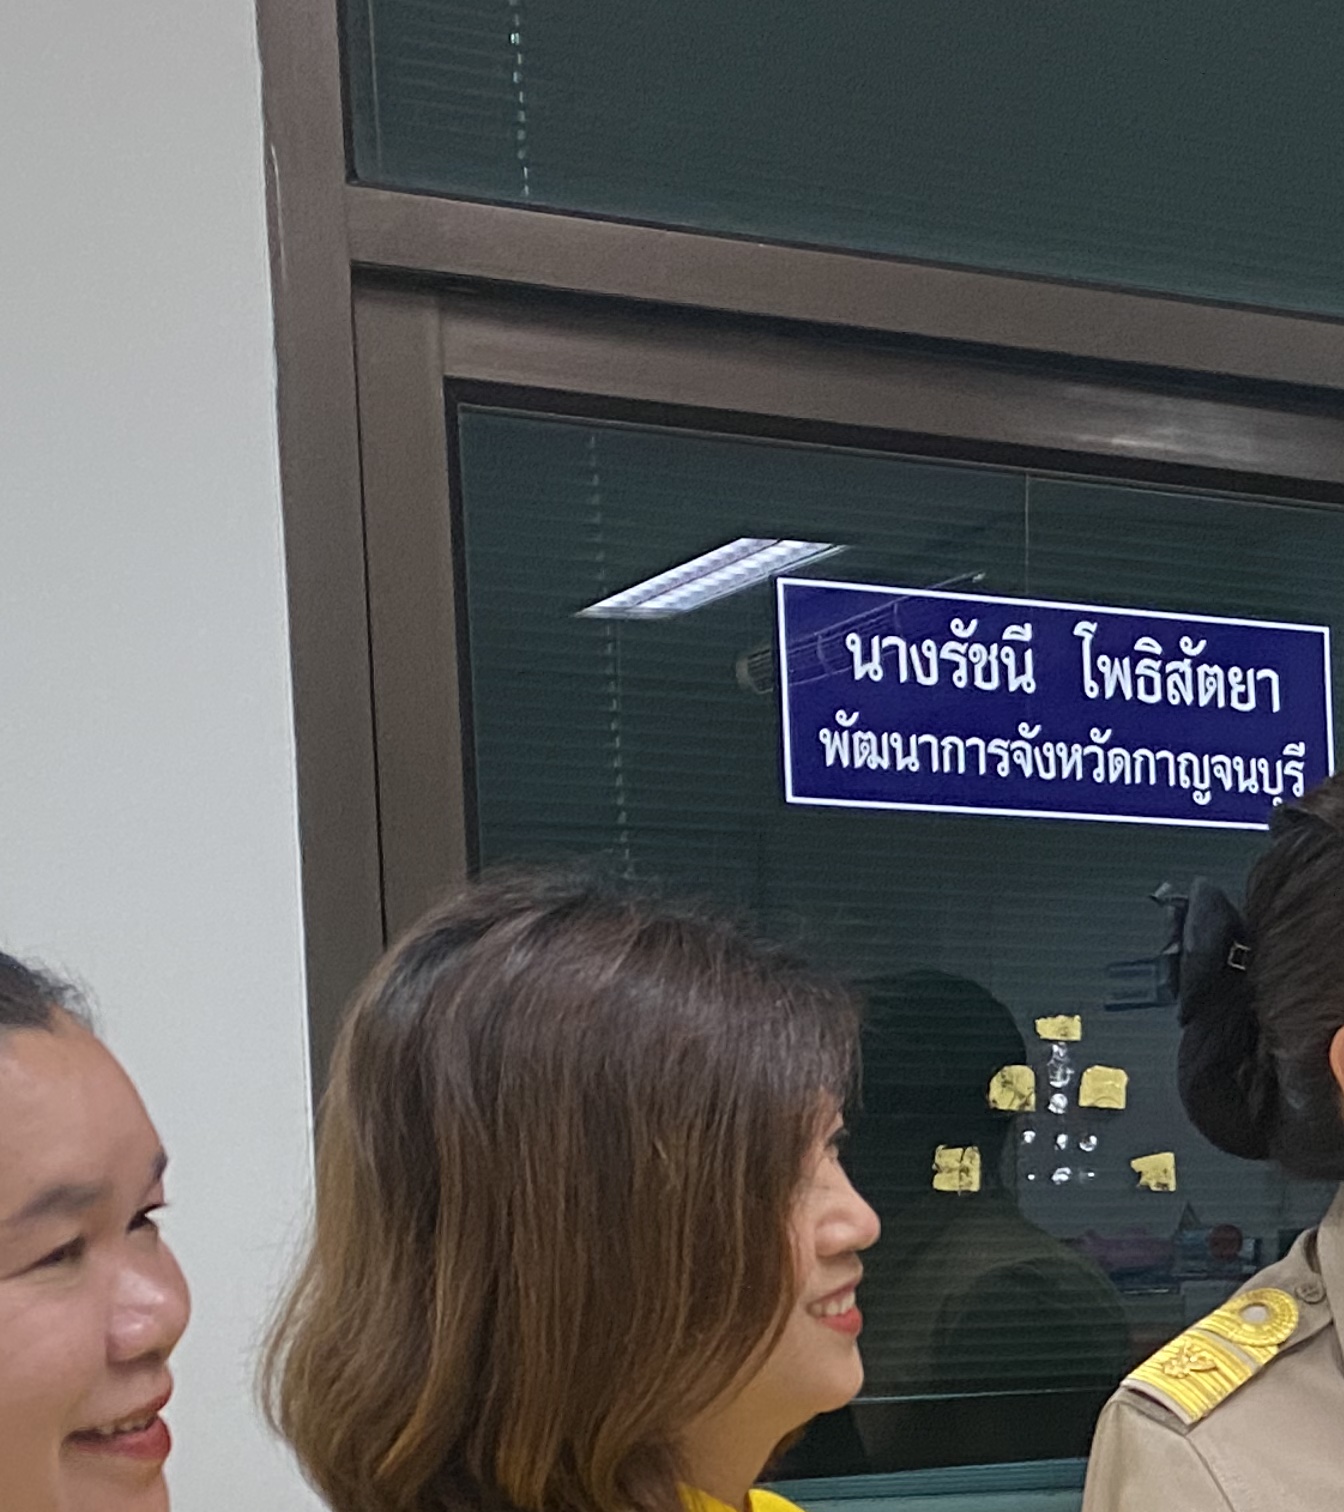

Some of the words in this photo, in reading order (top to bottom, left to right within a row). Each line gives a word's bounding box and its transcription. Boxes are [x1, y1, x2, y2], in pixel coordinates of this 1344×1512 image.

[845, 617, 1036, 694] นางรัชนี
[1073, 621, 1280, 713] โพธิสัตยา
[819, 709, 1306, 807] พัฒนาการจังหวัดกาญจนบุรี
